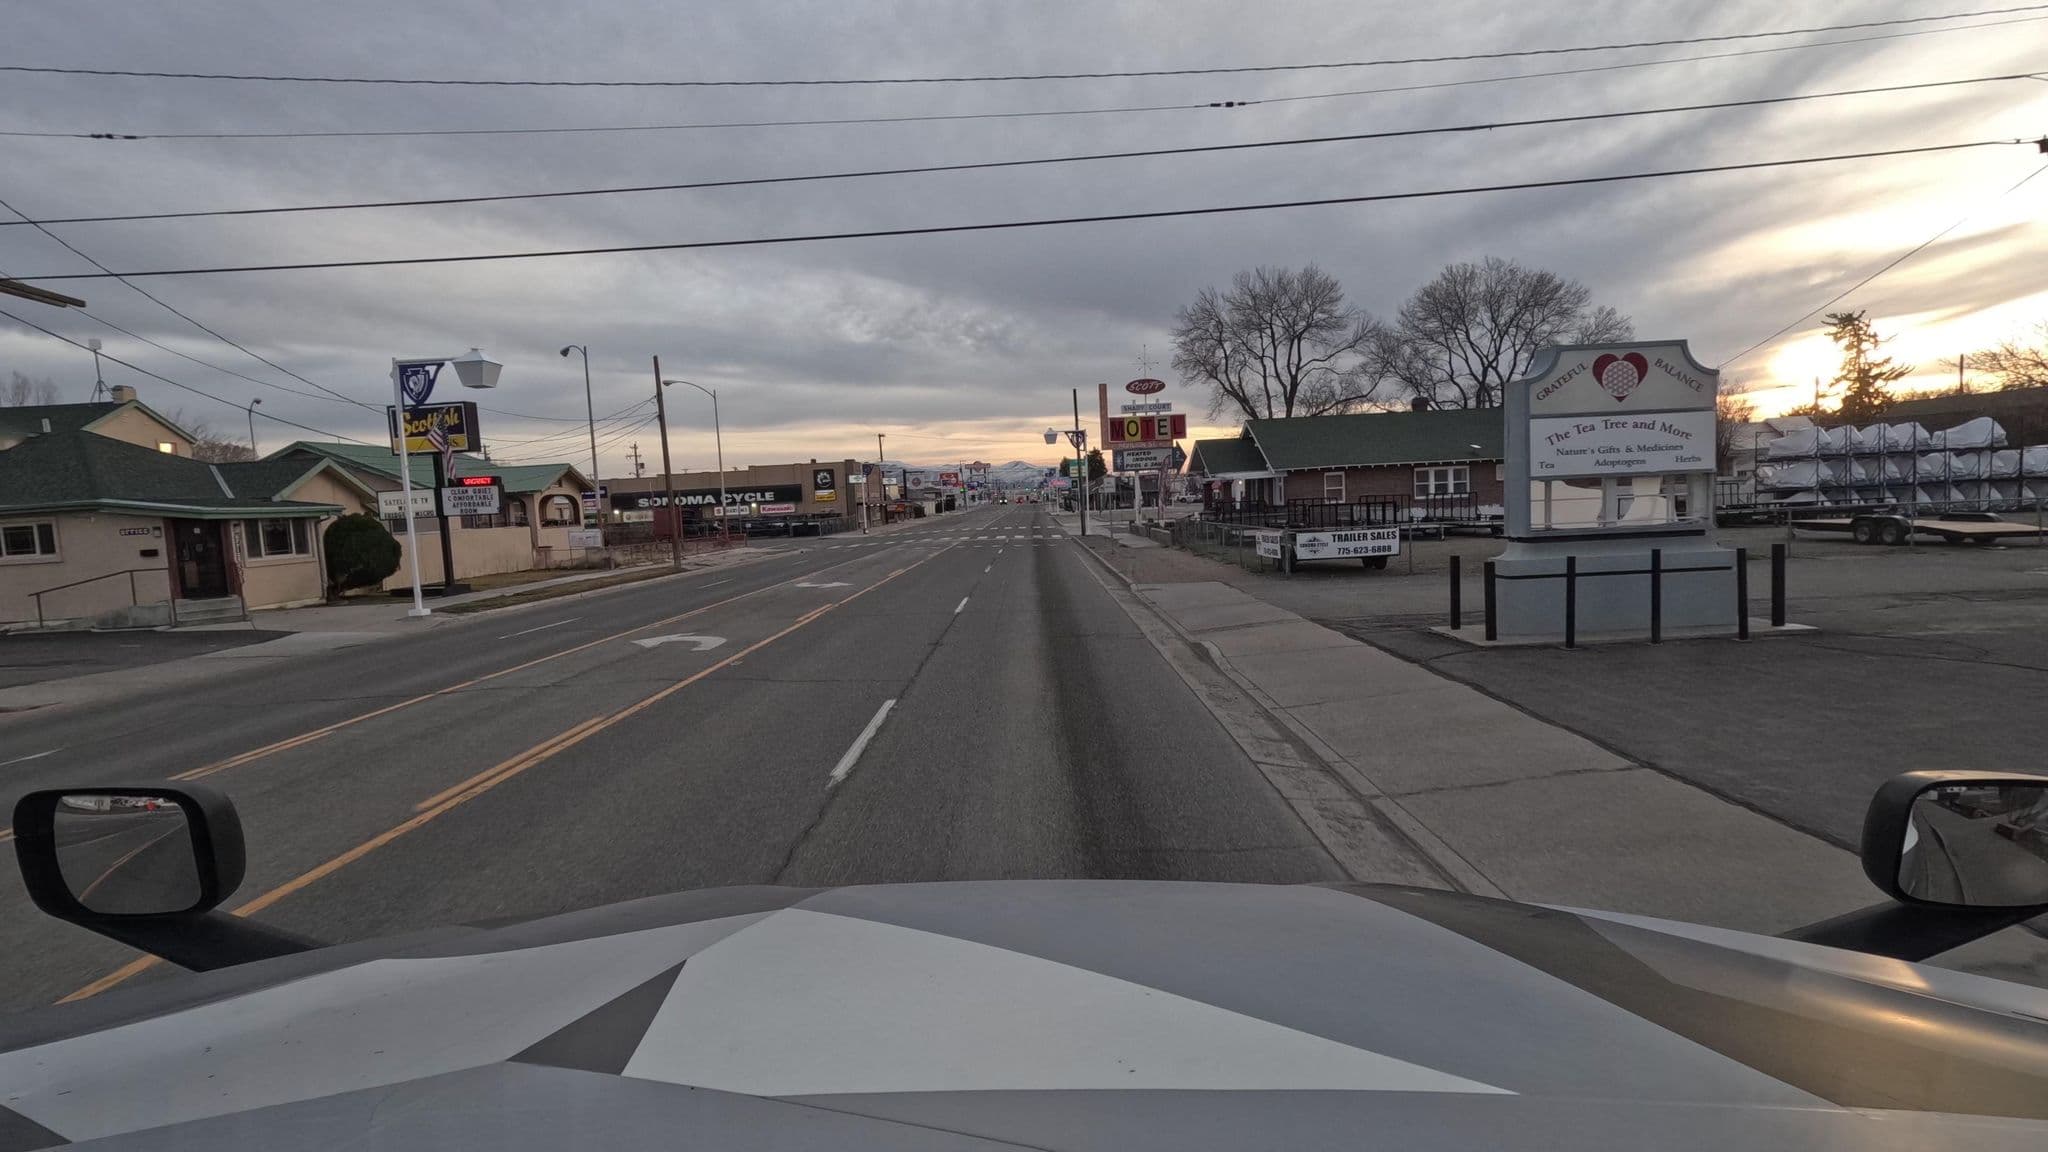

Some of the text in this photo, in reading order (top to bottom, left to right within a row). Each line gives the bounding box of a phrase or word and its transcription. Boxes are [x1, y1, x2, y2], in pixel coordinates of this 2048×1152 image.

[1536, 362, 1588, 400] GRATEFUL
[1654, 358, 1704, 393] BALANCE
[1128, 382, 1162, 391] SCOTT
[1111, 418, 1184, 440] MOTEL
[1545, 419, 1693, 446] The Tea Tree and More
[1556, 444, 1684, 456] Nature's Gifts & Medicines
[1538, 461, 1555, 469] Tea
[1674, 455, 1702, 463] Herbs
[721, 491, 775, 503] CYCLE
[1331, 531, 1397, 543] TRAILER SALES
[1337, 545, 1392, 555] 775-623-6888
